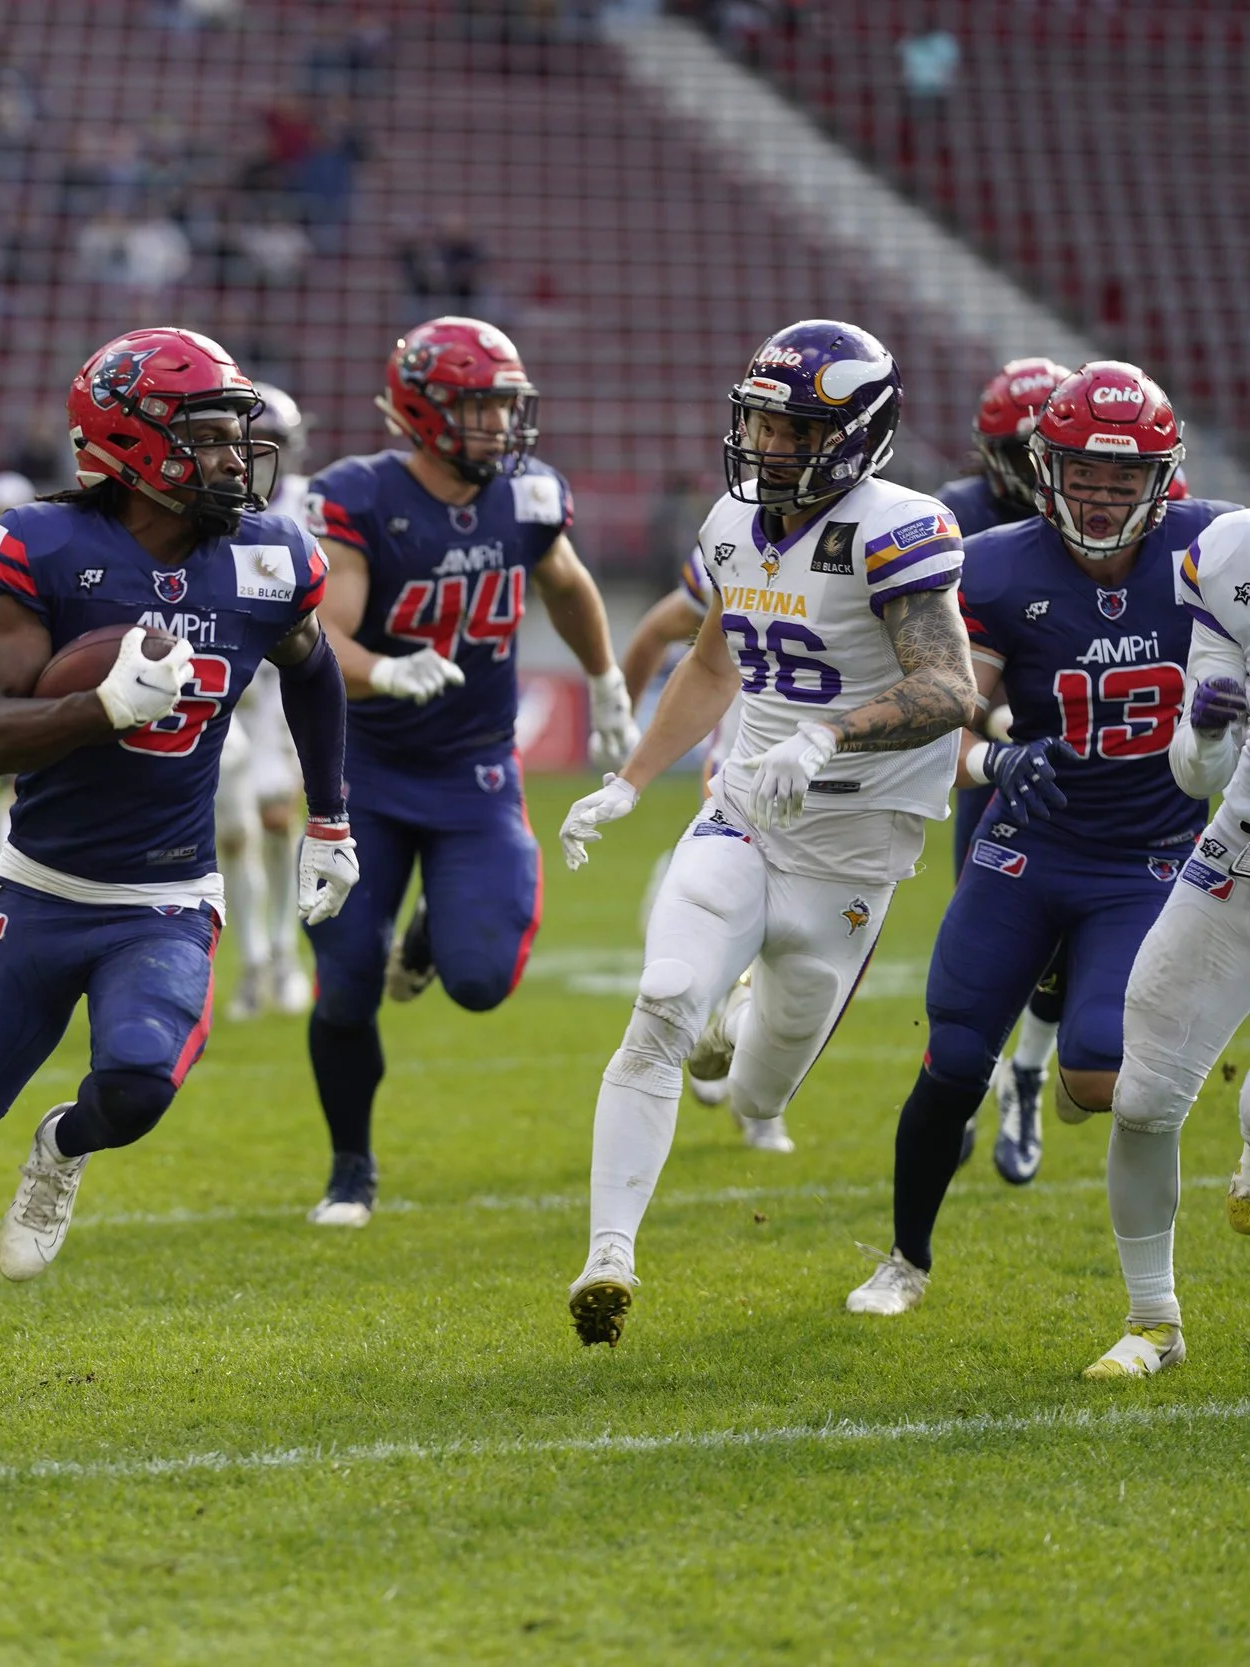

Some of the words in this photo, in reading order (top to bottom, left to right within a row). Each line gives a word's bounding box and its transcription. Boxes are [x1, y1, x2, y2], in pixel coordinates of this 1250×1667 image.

[758, 346, 803, 368] Chio
[1093, 386, 1144, 404] Chio
[897, 521, 925, 536] EUROPEAN
[901, 530, 928, 545] FOOTBALL
[431, 541, 503, 575] AMPri
[823, 562, 852, 574] BLACK
[258, 588, 292, 600] BLACK
[723, 585, 807, 618] VIENNA
[385, 565, 526, 663] 44
[721, 613, 842, 704] 36
[1076, 631, 1159, 664] AMPri
[118, 653, 232, 757] 6
[1053, 661, 1187, 760] 13
